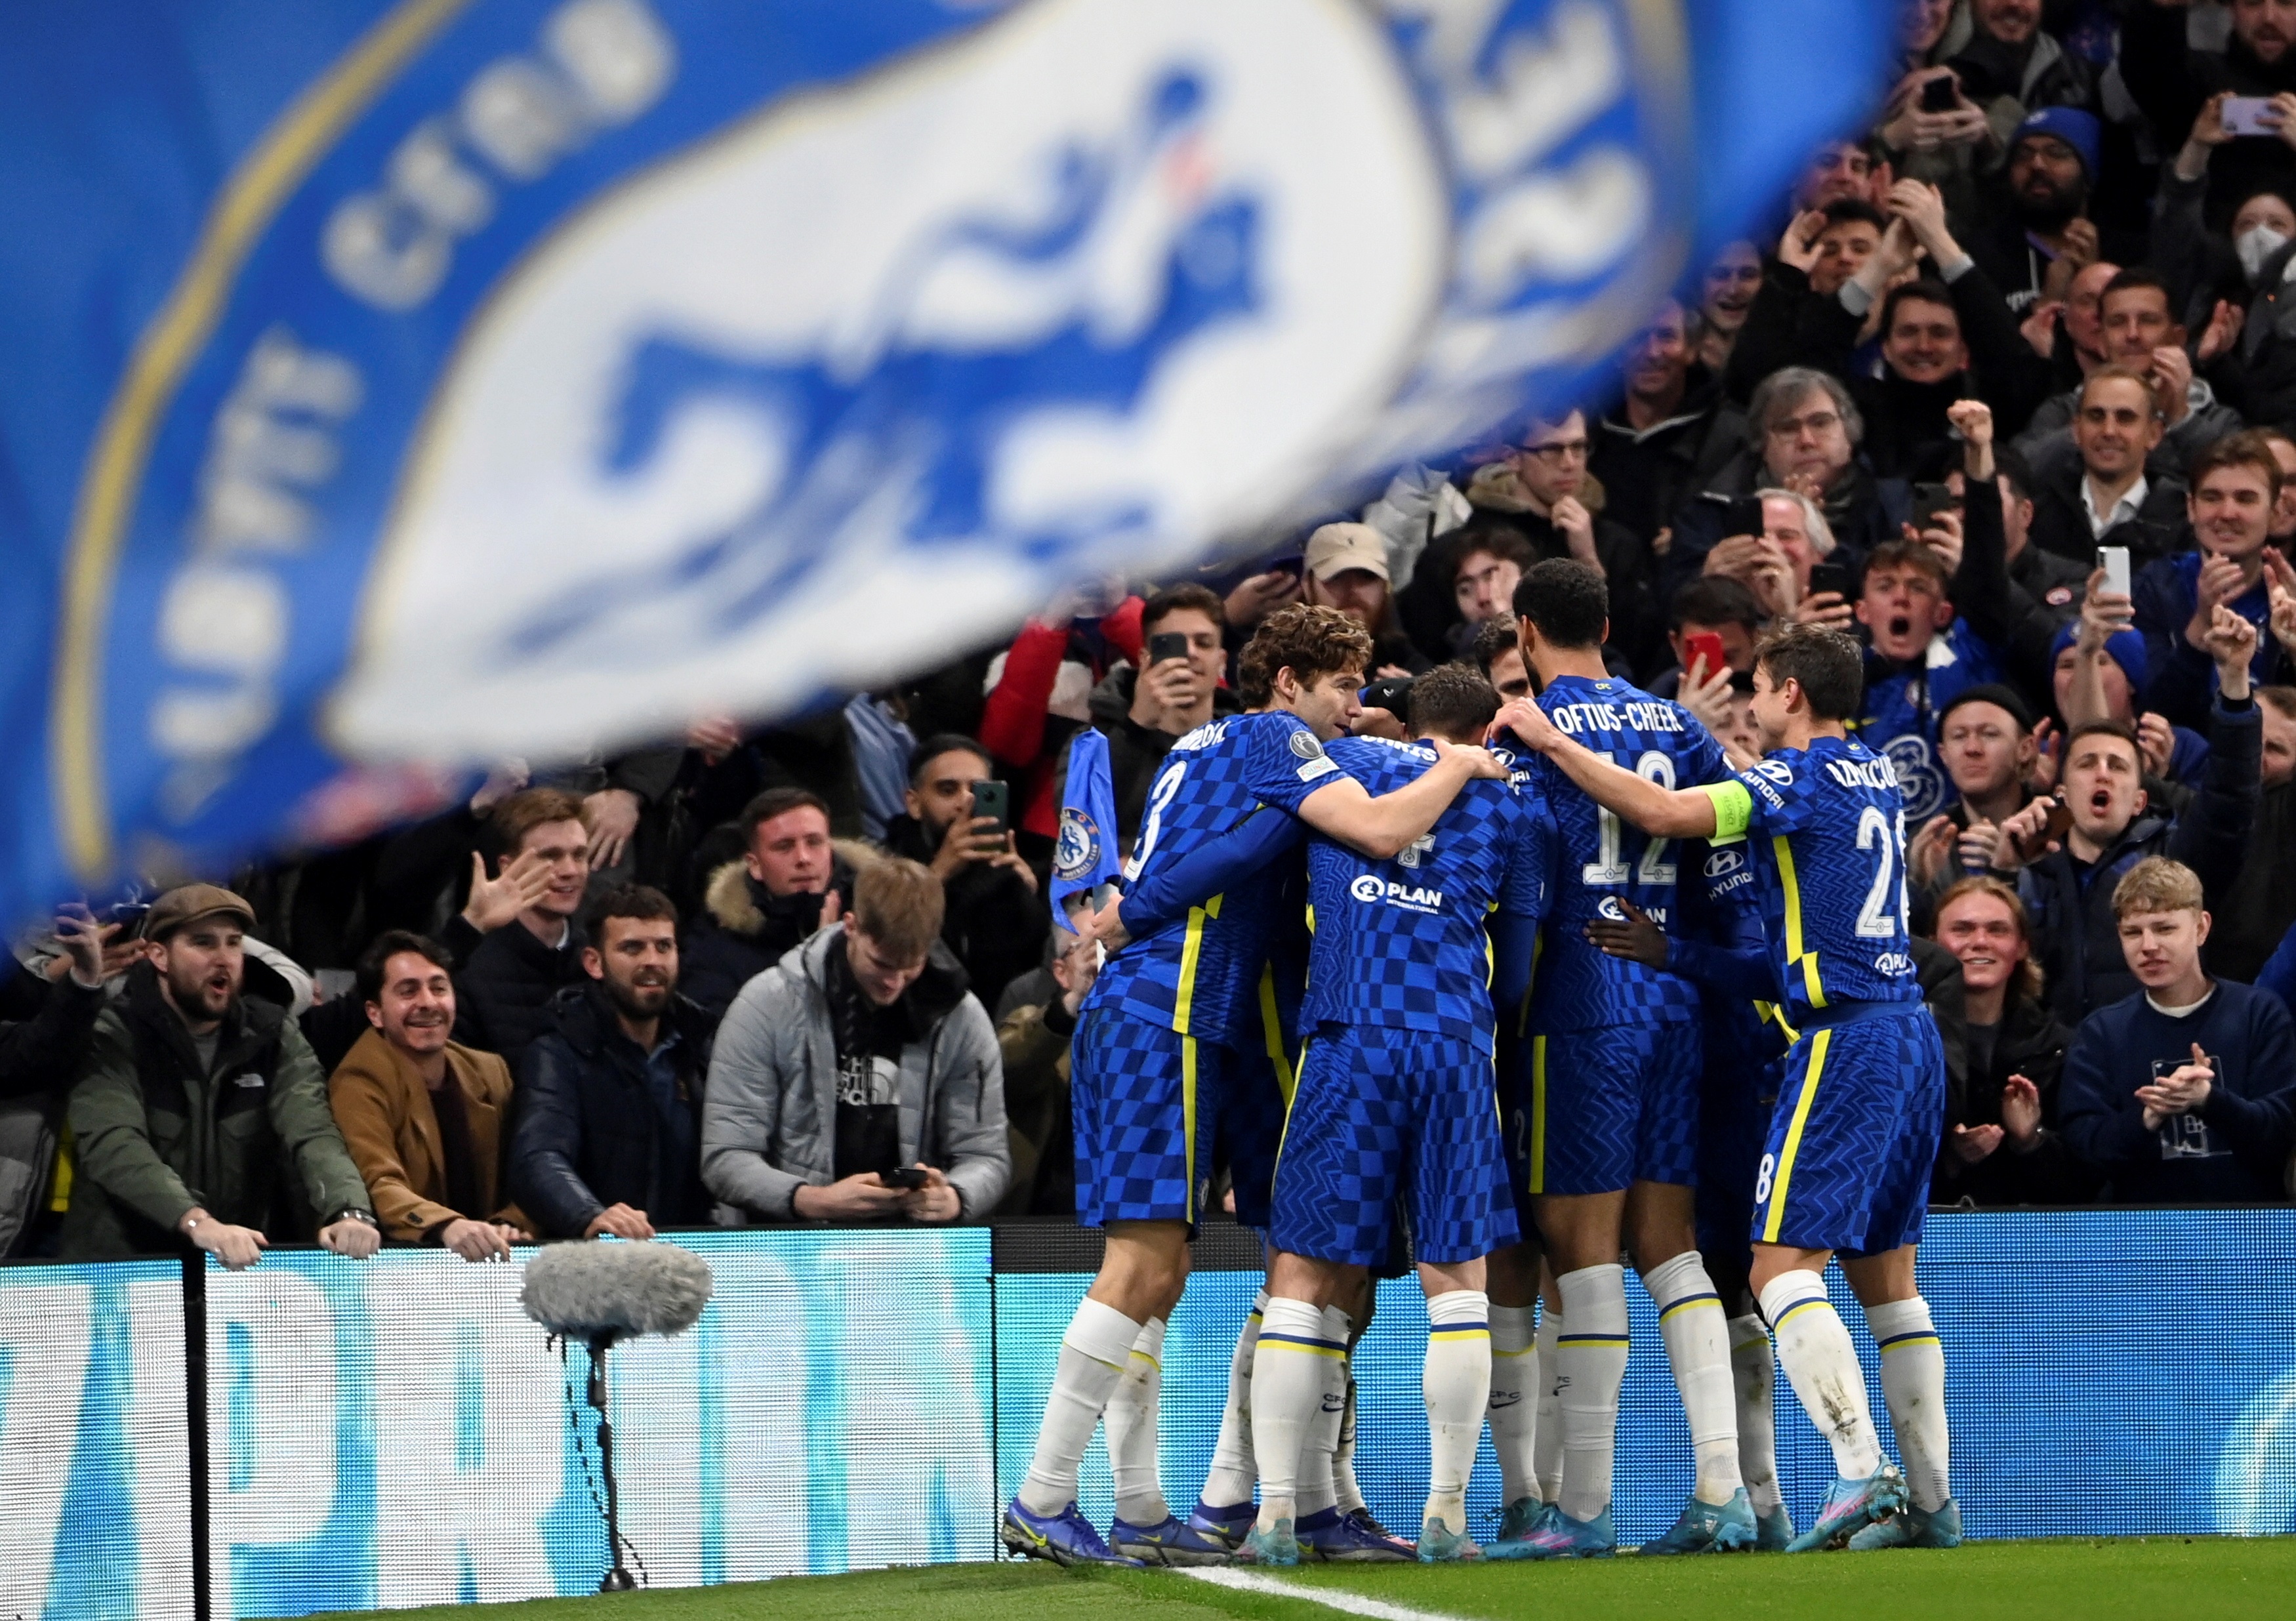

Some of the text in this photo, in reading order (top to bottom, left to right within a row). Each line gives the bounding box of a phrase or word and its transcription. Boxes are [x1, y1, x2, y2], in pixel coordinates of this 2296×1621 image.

[1552, 702, 1685, 735] OFTUS-CHEEK
[1123, 760, 1188, 882] 3
[1582, 750, 1677, 886] 12
[1385, 898, 1439, 915] INTERNATIONAL
[1387, 882, 1443, 907] PLAN
[1755, 1153, 1774, 1204] 8
